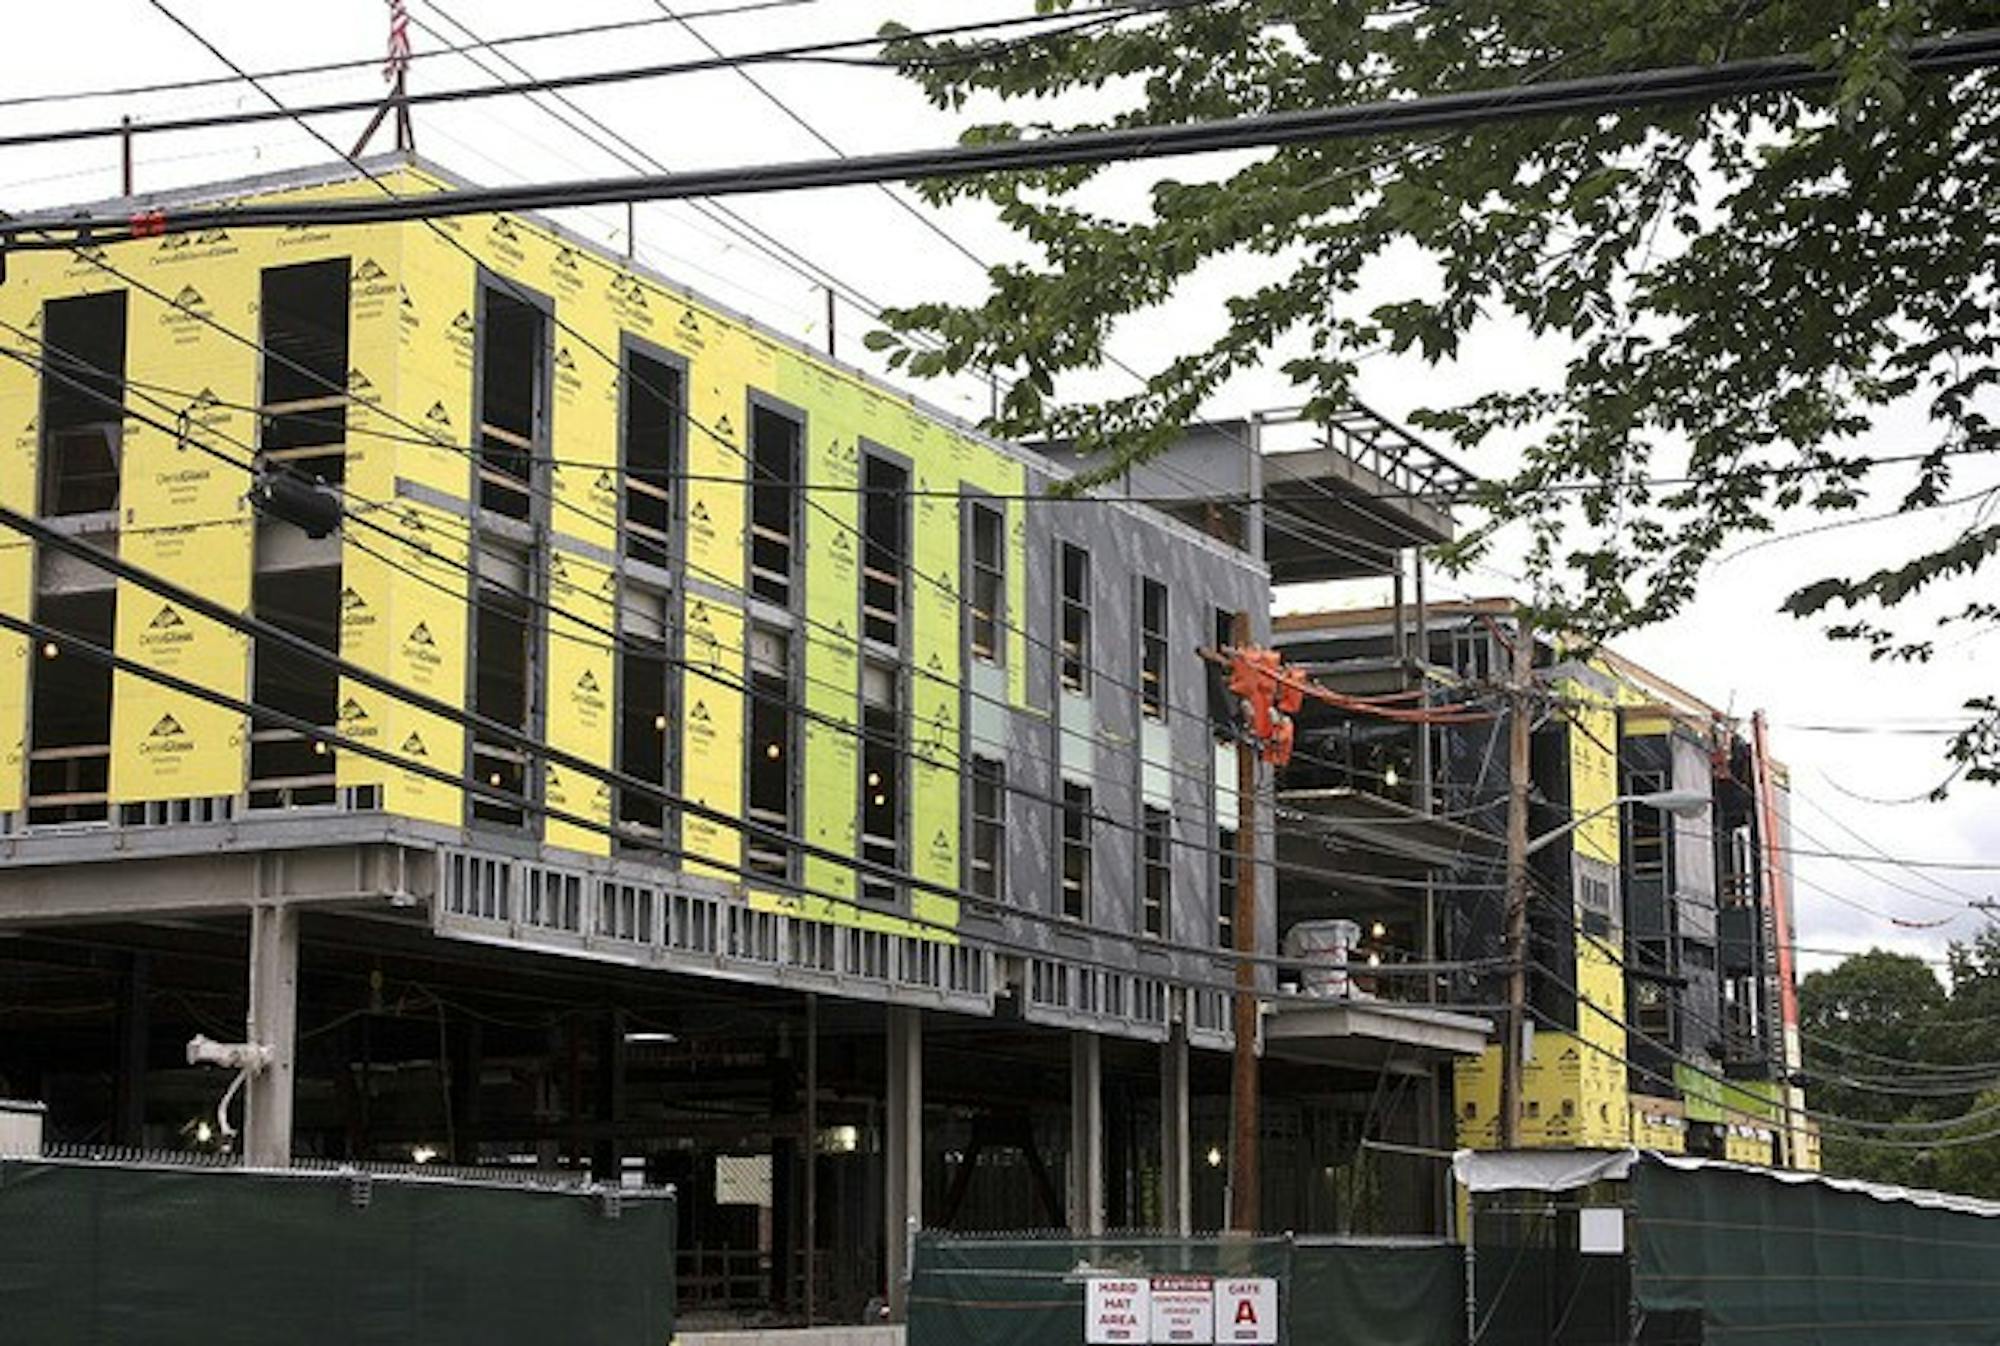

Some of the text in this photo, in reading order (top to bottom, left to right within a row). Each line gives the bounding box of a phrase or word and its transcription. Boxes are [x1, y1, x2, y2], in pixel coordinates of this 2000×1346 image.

[1228, 1283, 1260, 1296] GATE
[1104, 1298, 1132, 1309] HAT
[1234, 1299, 1258, 1325] A
[1098, 1314, 1138, 1326] AREA
